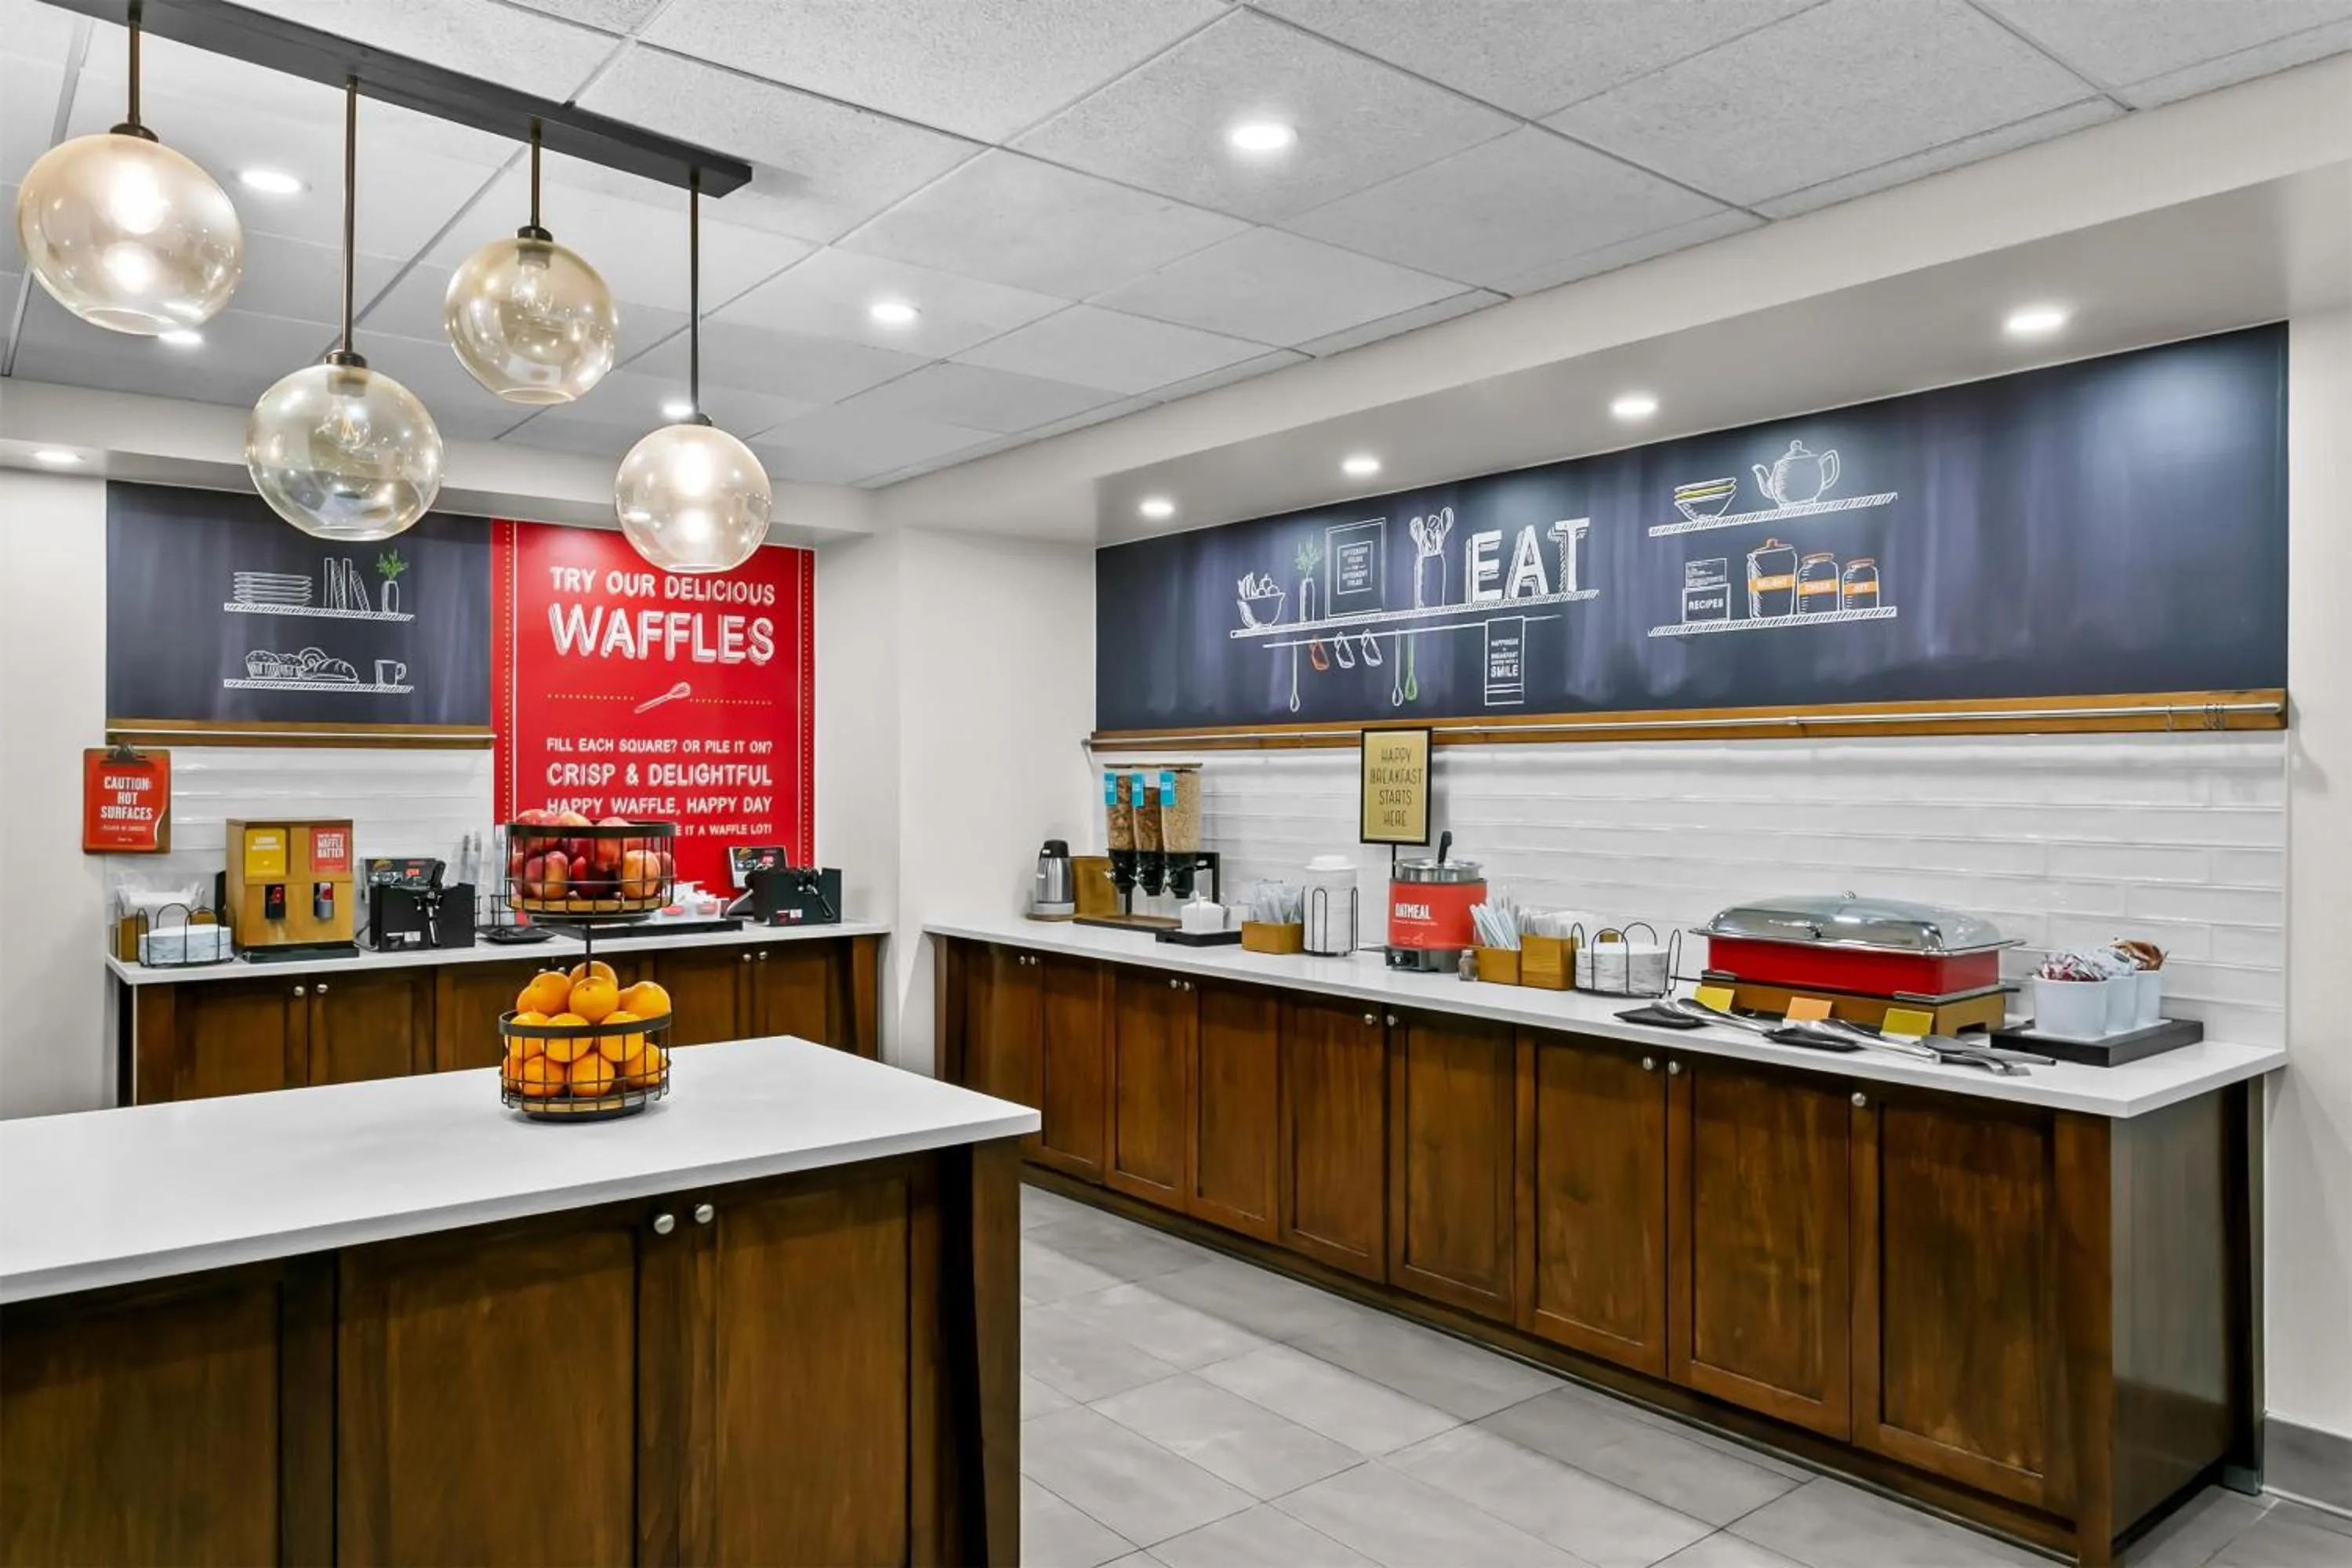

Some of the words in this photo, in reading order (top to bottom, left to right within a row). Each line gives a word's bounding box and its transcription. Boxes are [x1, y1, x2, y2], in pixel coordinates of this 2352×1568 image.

[1465, 517, 1590, 604] EAT
[550, 566, 596, 593] TRY
[605, 570, 656, 598] OUR
[665, 575, 775, 606] DELICIOUS
[1688, 598, 1724, 612] RECIPES
[548, 602, 775, 666] WAFFLES
[1490, 664, 1519, 678] SMILE
[546, 737, 573, 752] FILL
[579, 737, 614, 753] EACH
[619, 739, 677, 753] SQUARE?
[682, 739, 700, 753] OR
[705, 739, 731, 753] PILE
[734, 740, 746, 753] IT
[749, 740, 773, 754] ON?
[1381, 747, 1411, 763] HAPPY
[546, 761, 615, 786] CRISP
[625, 762, 640, 786] &
[648, 762, 773, 787] DELIGHTFUL
[1370, 768, 1424, 785] BREAKFAST
[103, 775, 152, 791] CAUTION
[117, 791, 139, 805] HOT
[1379, 789, 1412, 805] STARTS
[100, 805, 154, 821] SURFACES
[547, 797, 603, 815] HAPPY
[611, 796, 681, 816] WAFFLE,
[686, 796, 738, 815] HAPPY
[742, 796, 773, 815] DAY
[1384, 811, 1407, 827] HERE
[684, 826, 695, 837] IT
[698, 825, 706, 837] A
[709, 824, 748, 837] WAFFLE
[750, 823, 773, 836] LOT!
[1395, 902, 1431, 920] OATMEAL
